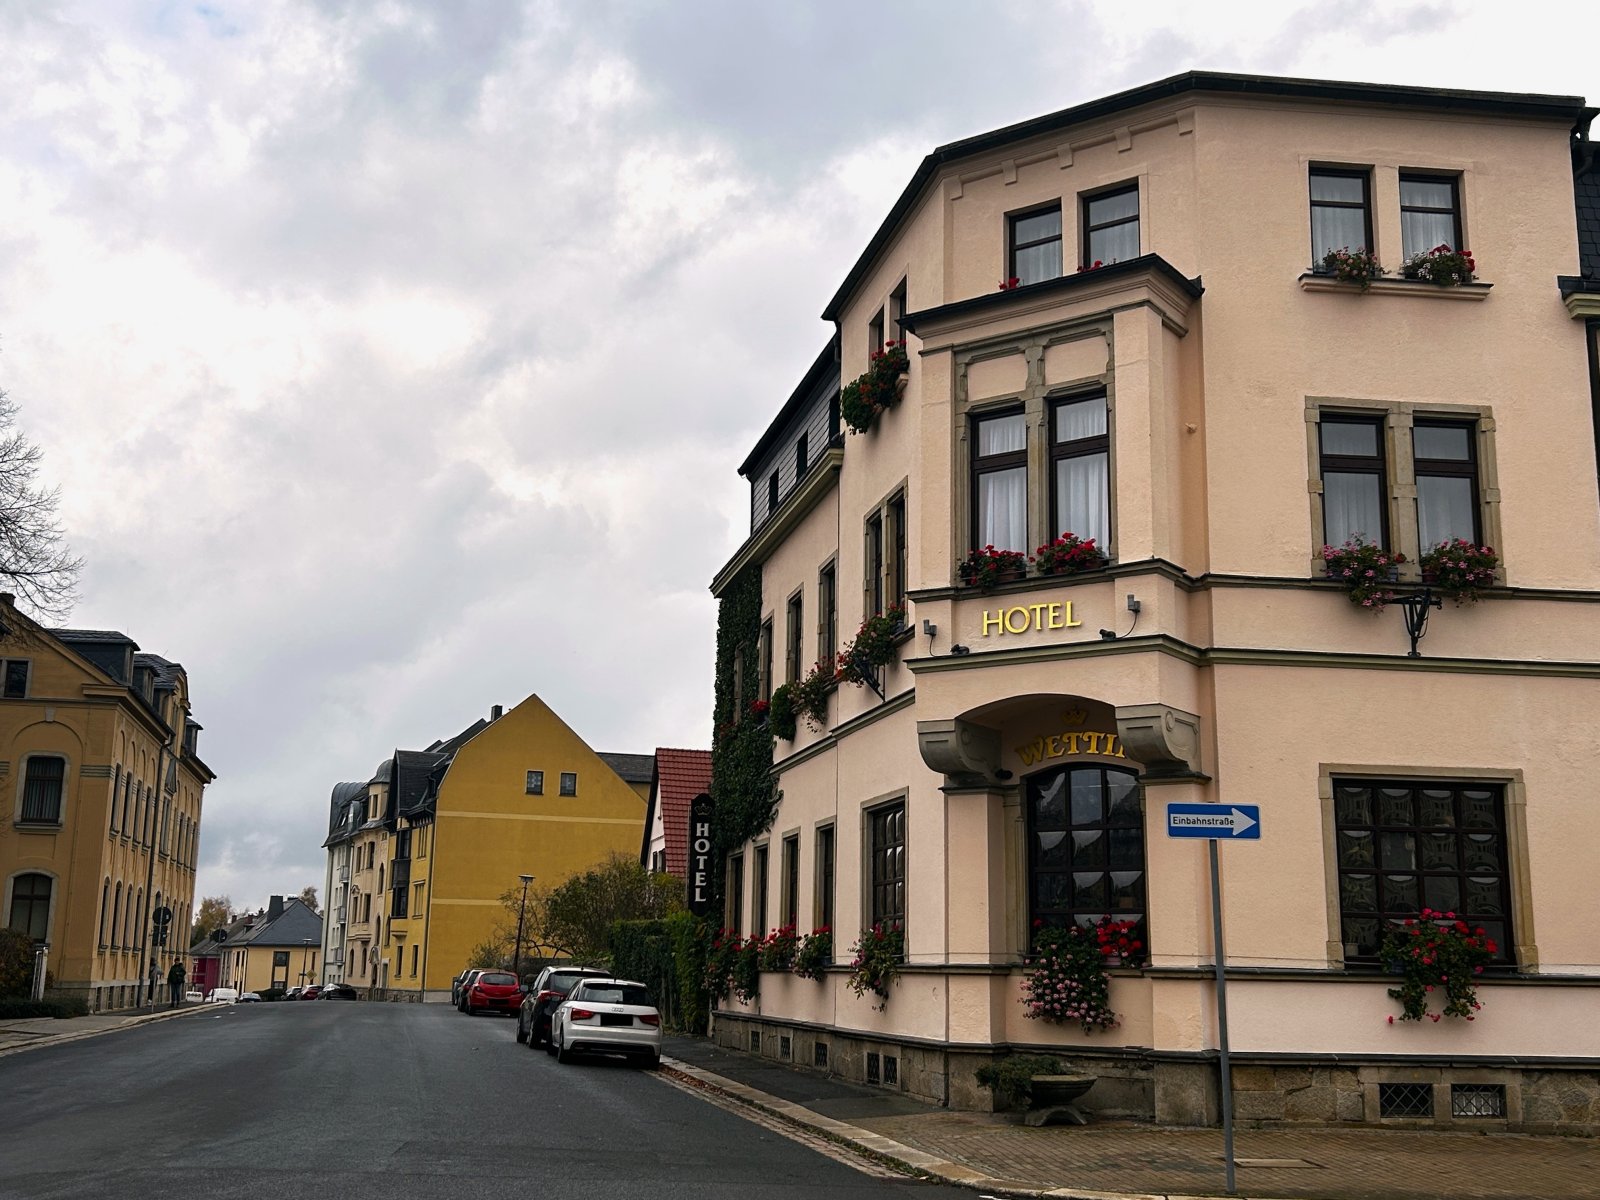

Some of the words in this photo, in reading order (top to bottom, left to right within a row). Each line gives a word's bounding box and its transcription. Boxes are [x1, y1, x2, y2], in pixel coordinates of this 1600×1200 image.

[982, 600, 1082, 636] HOTEL
[1172, 816, 1235, 826] Einbahnstraße
[694, 822, 711, 902] HOTEL
